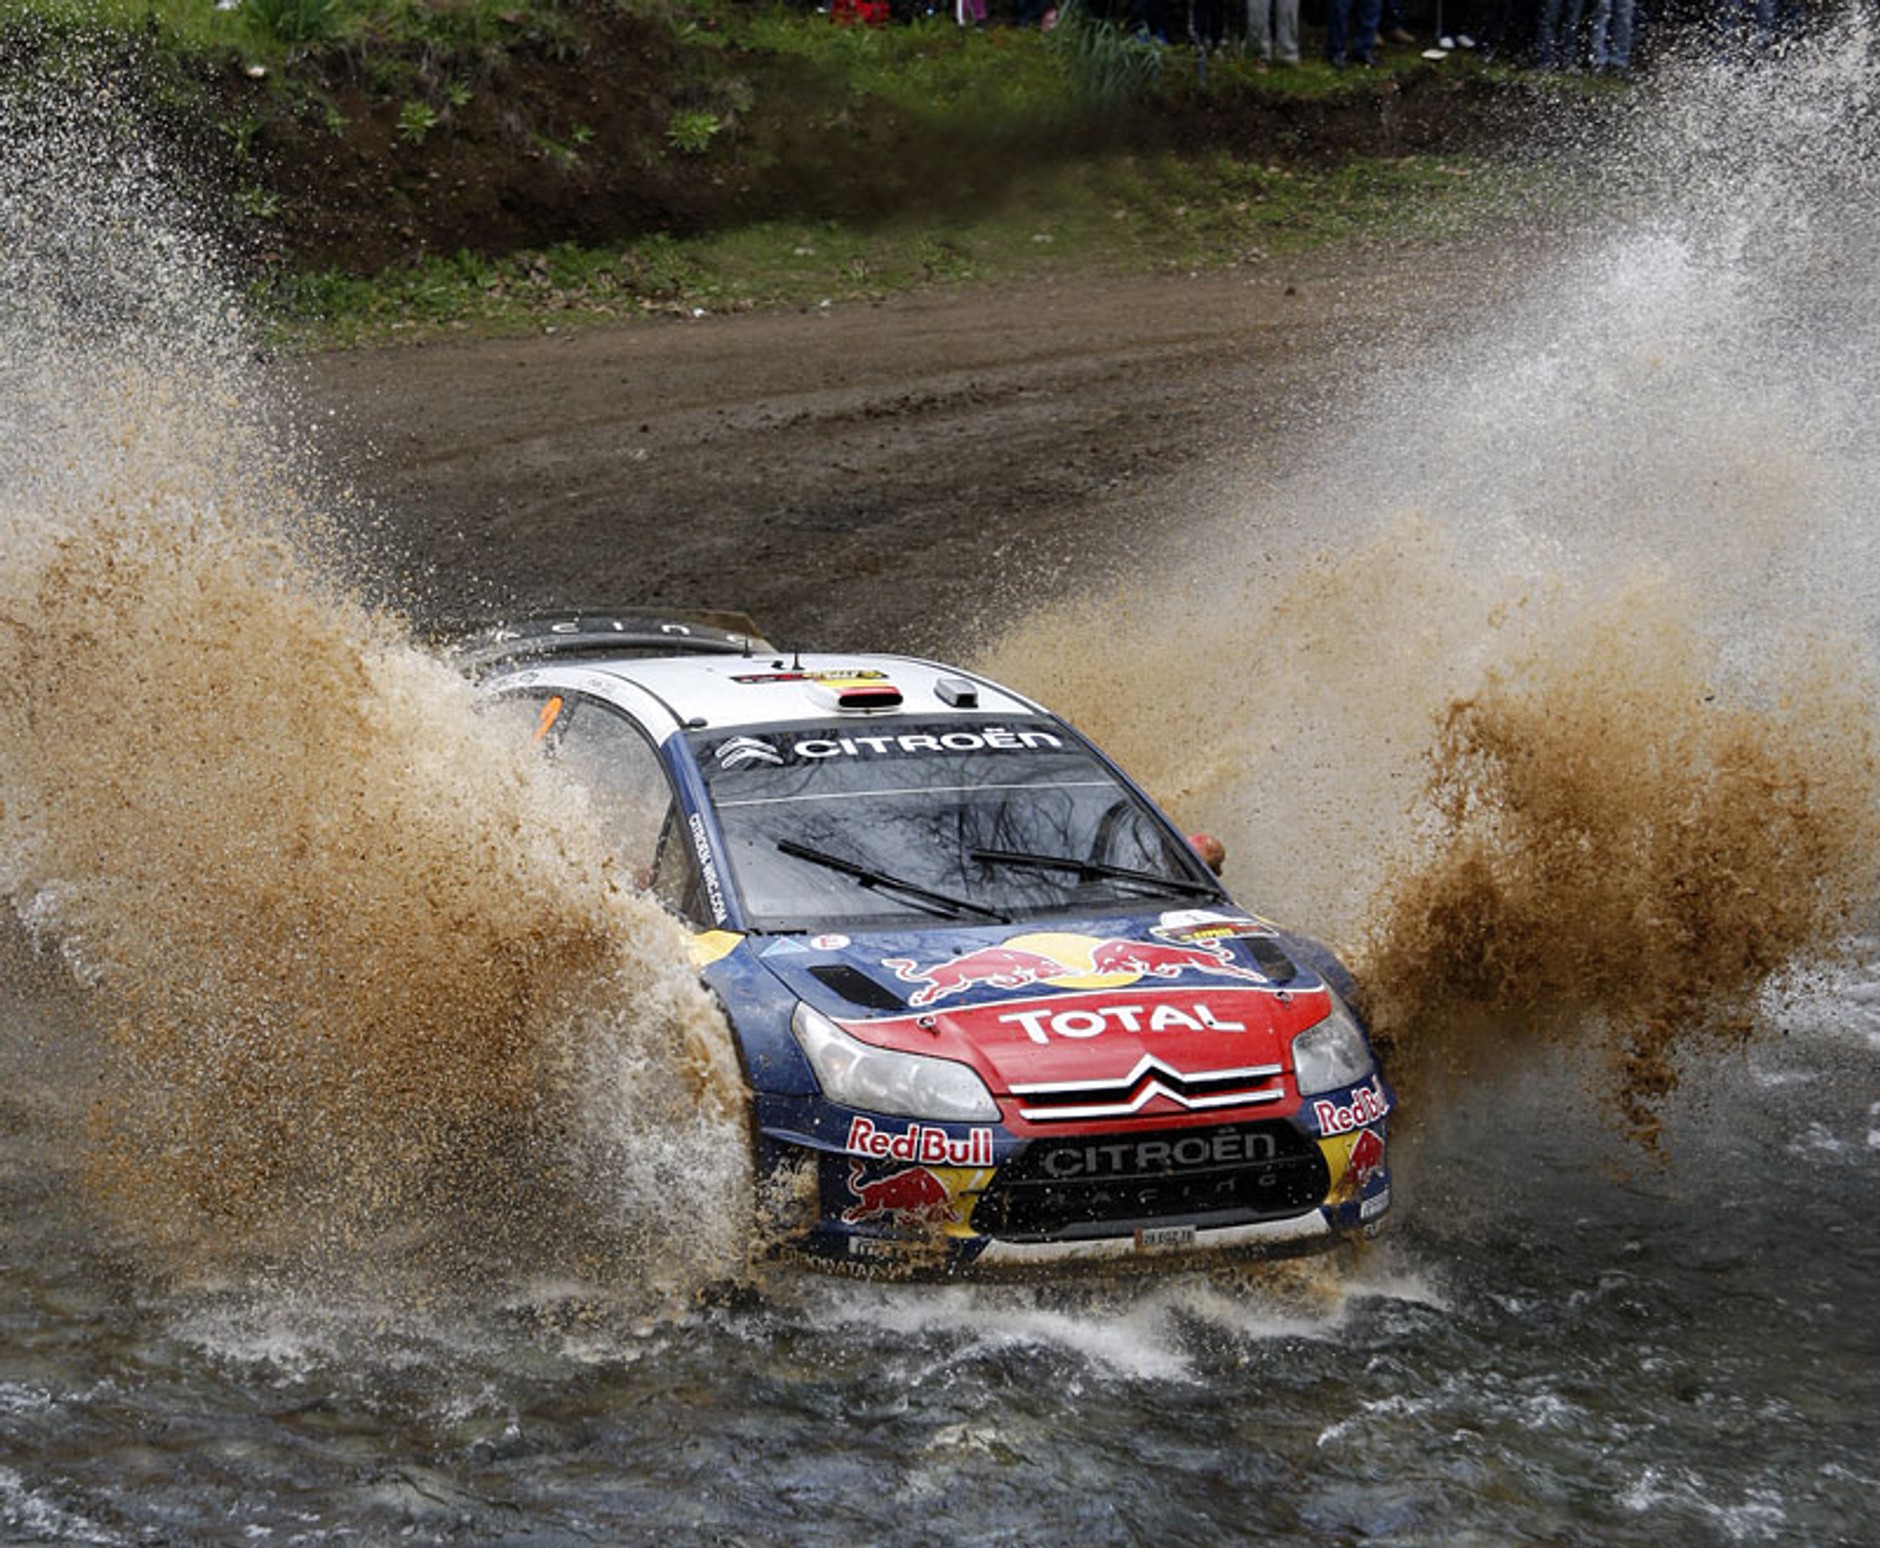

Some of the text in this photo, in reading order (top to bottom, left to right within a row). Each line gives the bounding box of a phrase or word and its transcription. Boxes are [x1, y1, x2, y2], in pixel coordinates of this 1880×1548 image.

[794, 727, 1063, 758] CITROËN
[998, 1003, 1247, 1045] TOTAL
[1313, 1089, 1370, 1136] Red
[847, 1116, 993, 1166] Red Bull
[1043, 1126, 1277, 1176] CITROËN
